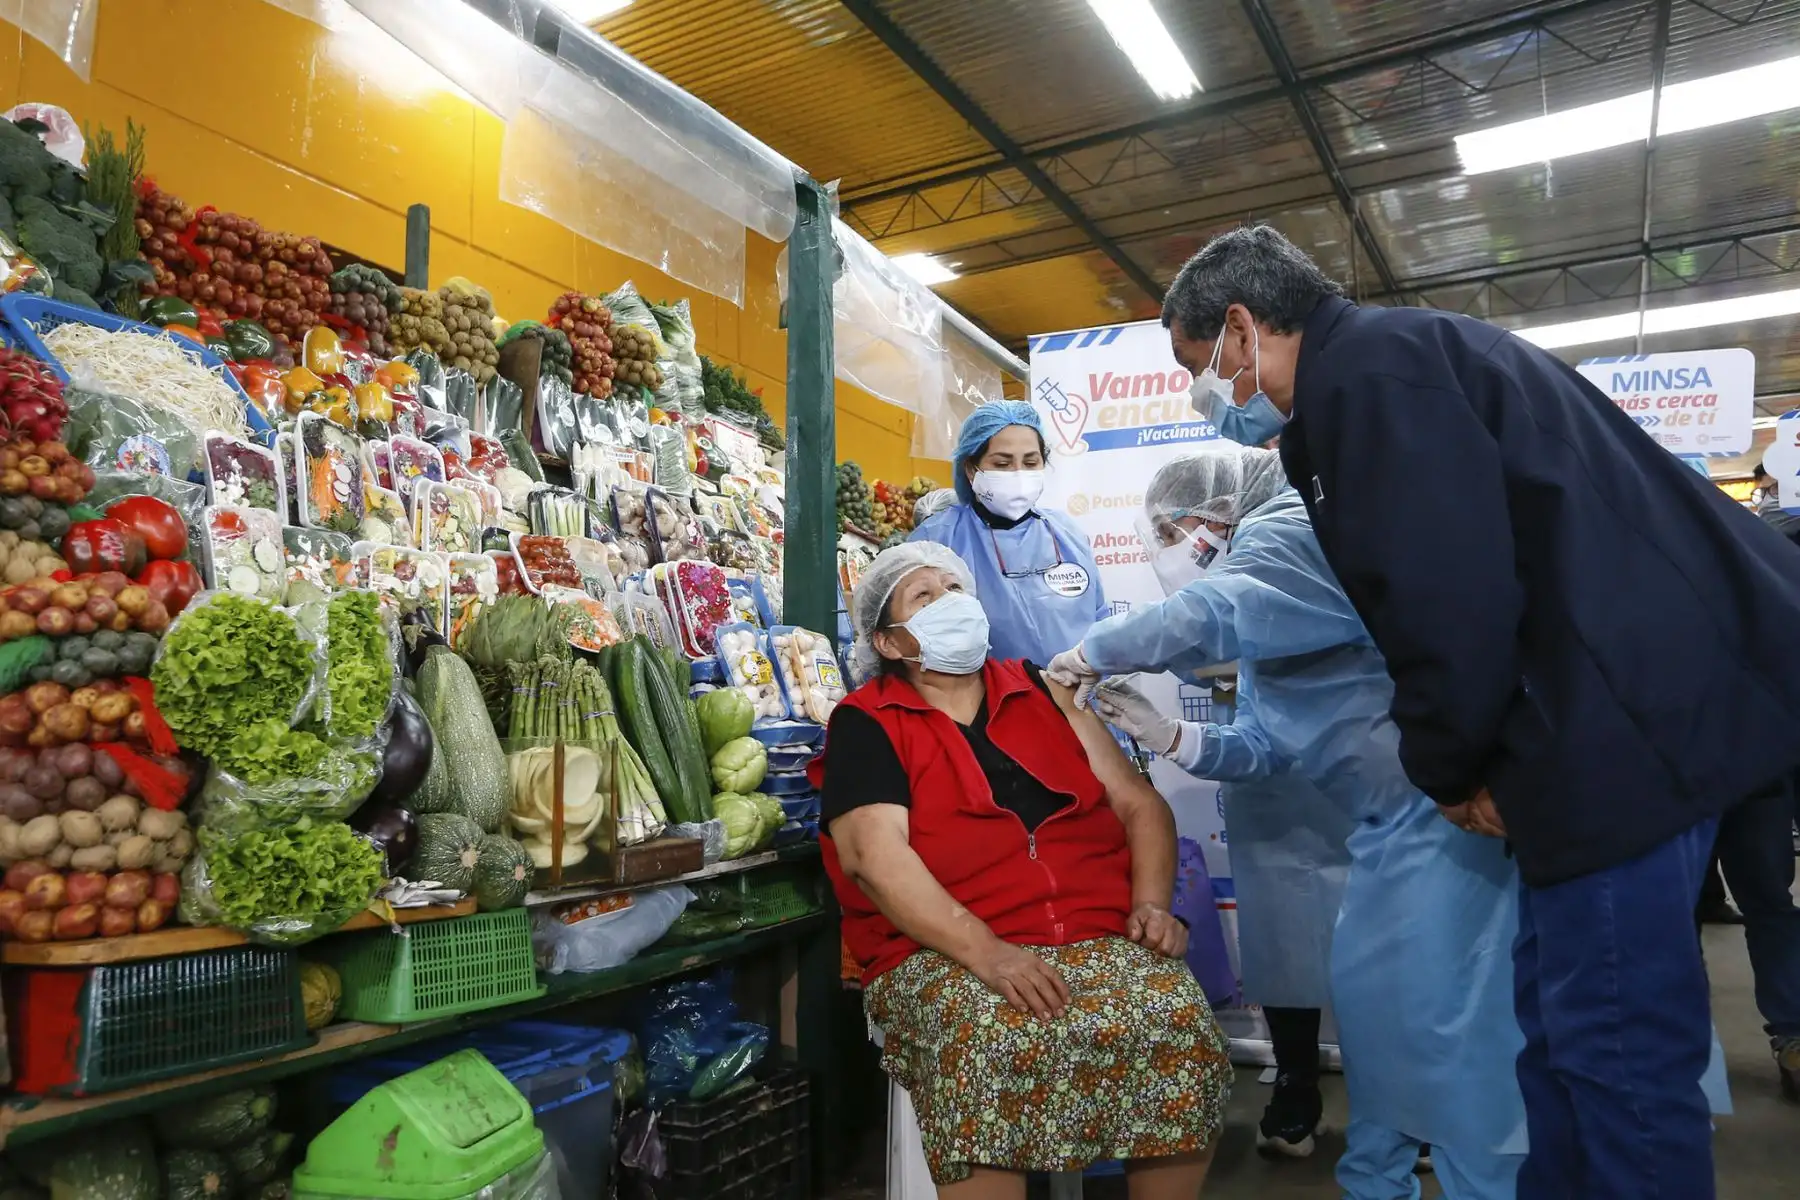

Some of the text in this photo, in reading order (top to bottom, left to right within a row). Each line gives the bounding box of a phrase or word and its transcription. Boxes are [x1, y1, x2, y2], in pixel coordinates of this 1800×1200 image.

[1089, 370, 1189, 401] Vamo
[1612, 367, 1713, 393] MINSA
[1656, 394, 1718, 410] cerca
[1664, 408, 1721, 428] de tí
[1137, 424, 1216, 445] ¡Vacúnate
[1092, 493, 1143, 509] Ponte
[1048, 571, 1082, 581] MINSA
